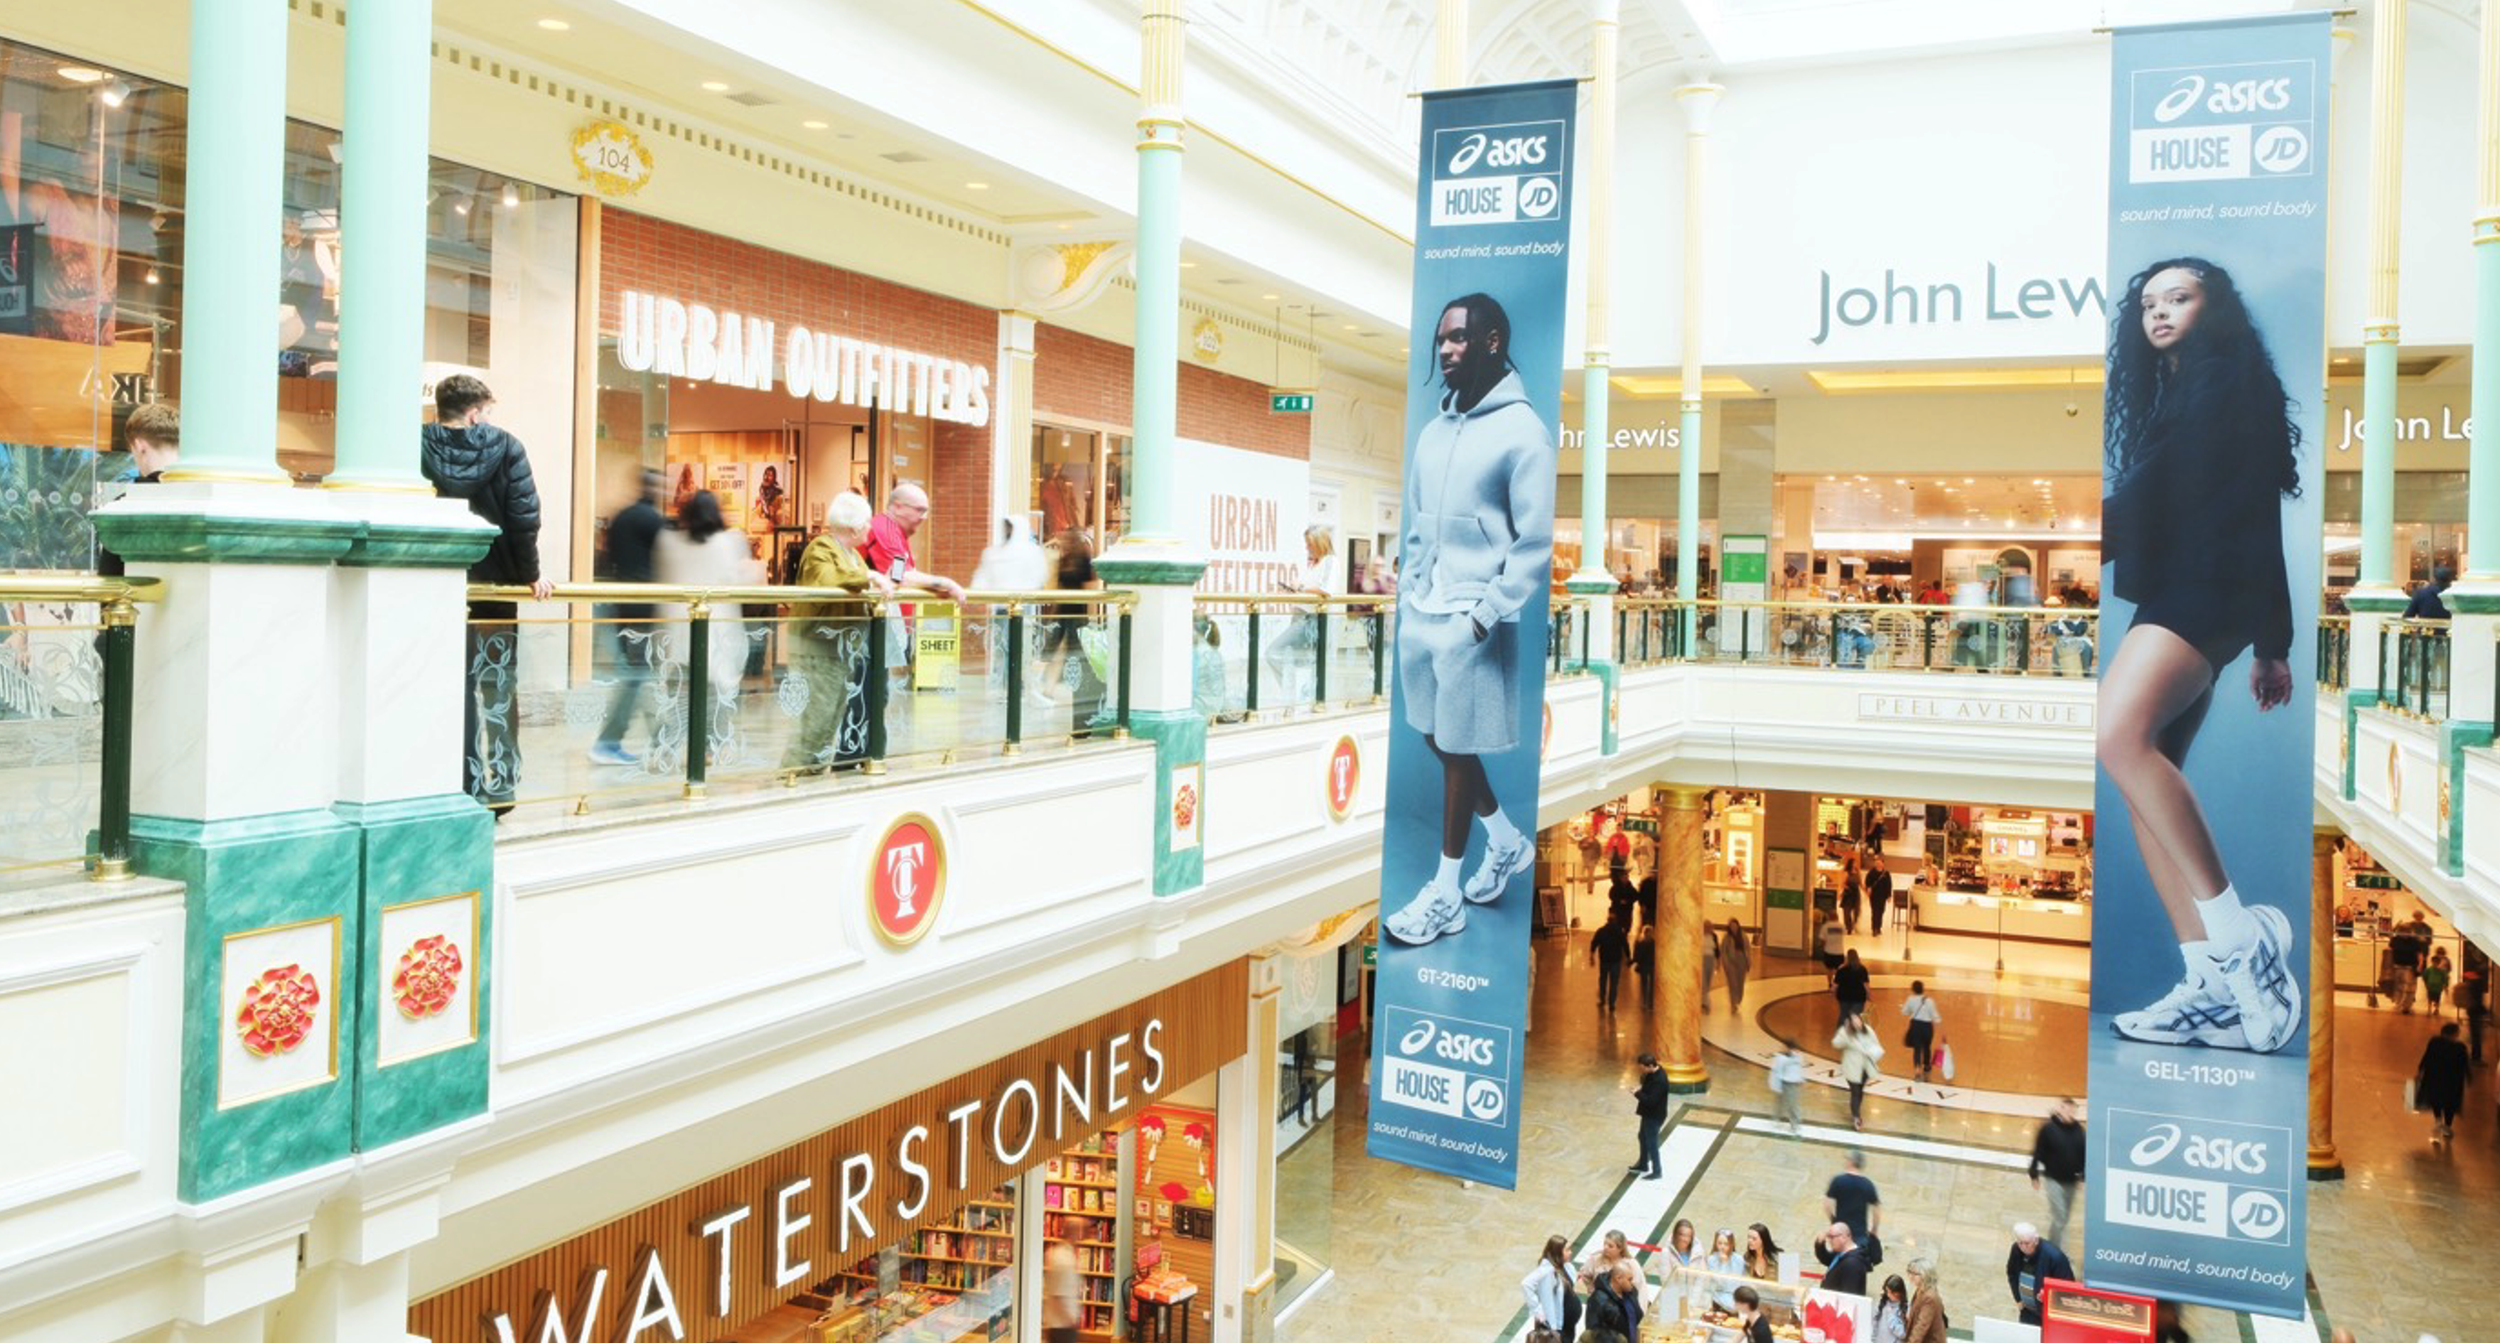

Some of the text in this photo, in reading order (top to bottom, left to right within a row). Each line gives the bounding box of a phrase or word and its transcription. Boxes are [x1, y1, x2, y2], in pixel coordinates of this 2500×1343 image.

[2207, 77, 2290, 113] asics
[599, 146, 629, 173] 104
[1487, 136, 1547, 167] asics
[2150, 137, 2301, 171] HOUSE JD
[1445, 186, 1553, 215] HOUSE JD
[2120, 200, 2317, 222] sound mind, sound body
[1424, 240, 1565, 259] sound mind, sound body
[1810, 260, 2107, 346] John Lew
[617, 290, 990, 428] URBAN OUTFITTERS
[1606, 420, 1680, 449] ewis
[1210, 493, 1277, 552] URBAN
[920, 639, 955, 651] SHEET
[1876, 698, 2078, 722] PEEL AVENUE
[1436, 1030, 1495, 1065] asics
[1396, 1068, 1499, 1110] HOUSE JD
[1374, 1121, 1508, 1163] sound mind, sound body
[2184, 1134, 2267, 1175] asics
[495, 1018, 1163, 1343] WATERSTONES
[2126, 1182, 2278, 1227] HOUSE JD
[2095, 1249, 2295, 1290] sound mind, sound body
